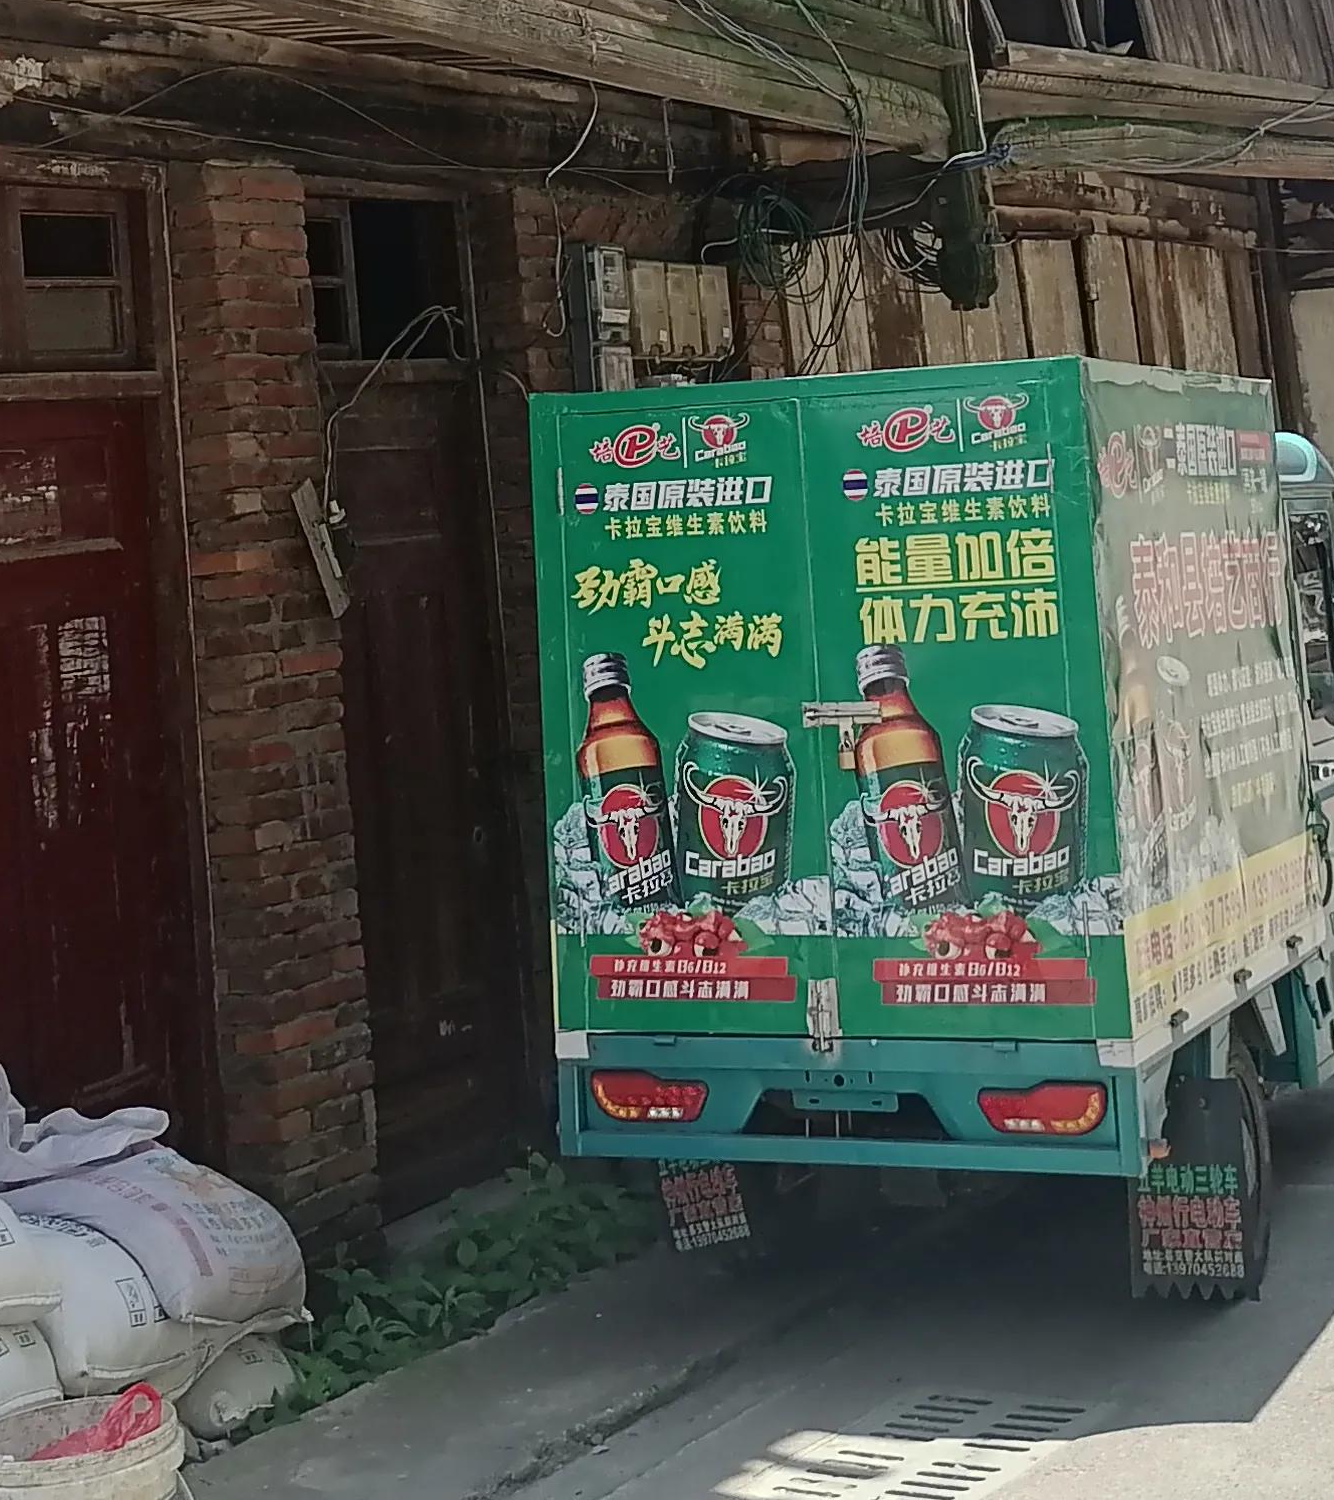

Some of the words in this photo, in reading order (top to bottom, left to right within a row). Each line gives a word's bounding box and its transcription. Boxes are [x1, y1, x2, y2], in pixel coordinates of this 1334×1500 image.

[603, 476, 772, 512] 泰国原装进口
[873, 459, 1055, 497] 泰国原装进口
[605, 509, 766, 540] 卡拉宝维生素饮料
[875, 493, 1051, 527] 卡拉宝维生素饮料
[855, 527, 1056, 585] 能量加倍
[571, 557, 722, 616] 劲霸口感
[860, 588, 1059, 645] 体力充沛
[642, 610, 783, 670] 斗志满满
[608, 849, 672, 895] arabao
[686, 849, 776, 879] Carabao
[889, 847, 959, 897] arabao
[974, 846, 1070, 877] Carabao
[610, 979, 749, 999] 劲霸口感斗志满满
[896, 983, 1046, 1003] 劲霸口感斗志满满
